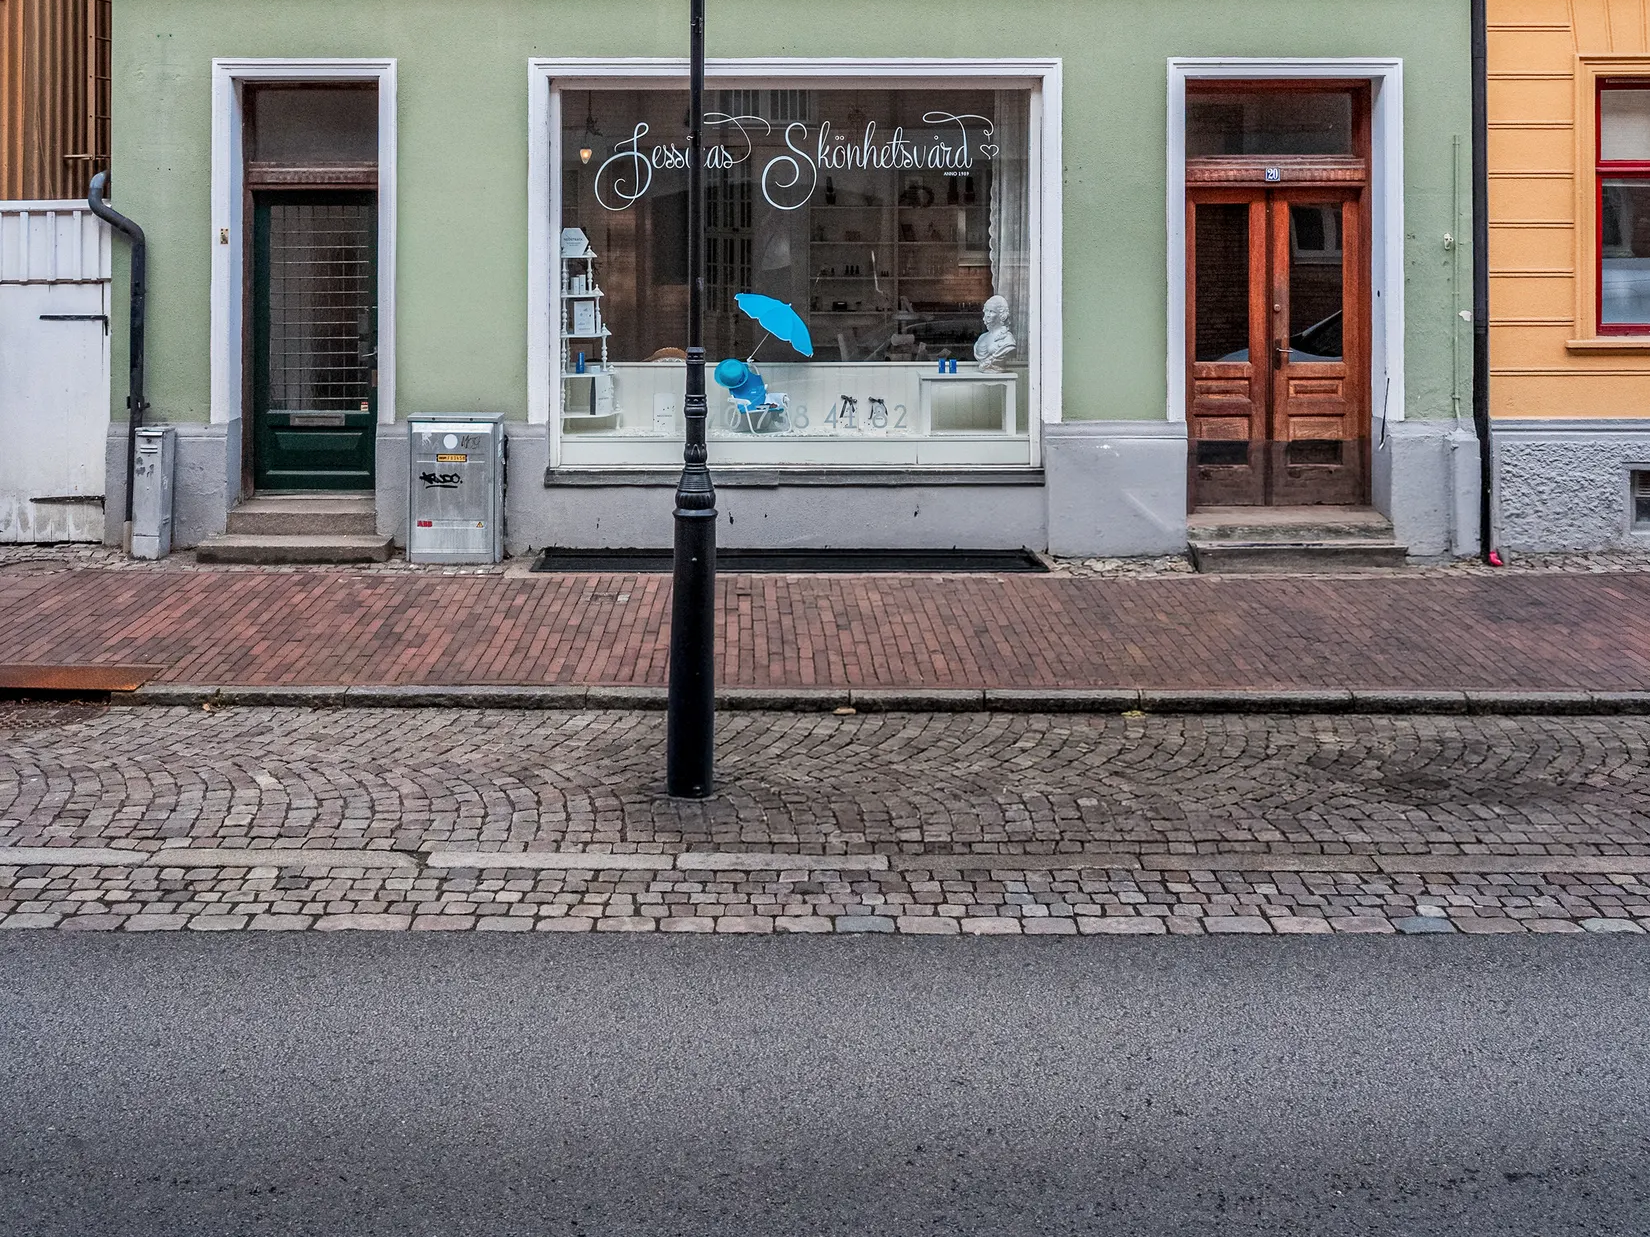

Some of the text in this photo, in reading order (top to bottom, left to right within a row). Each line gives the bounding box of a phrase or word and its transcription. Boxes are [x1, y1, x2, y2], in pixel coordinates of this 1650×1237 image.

[594, 111, 994, 211] Jessias Skönhetsvård
[1267, 169, 1279, 180] 20
[872, 404, 907, 429] 82
[417, 520, 433, 528] ABB
